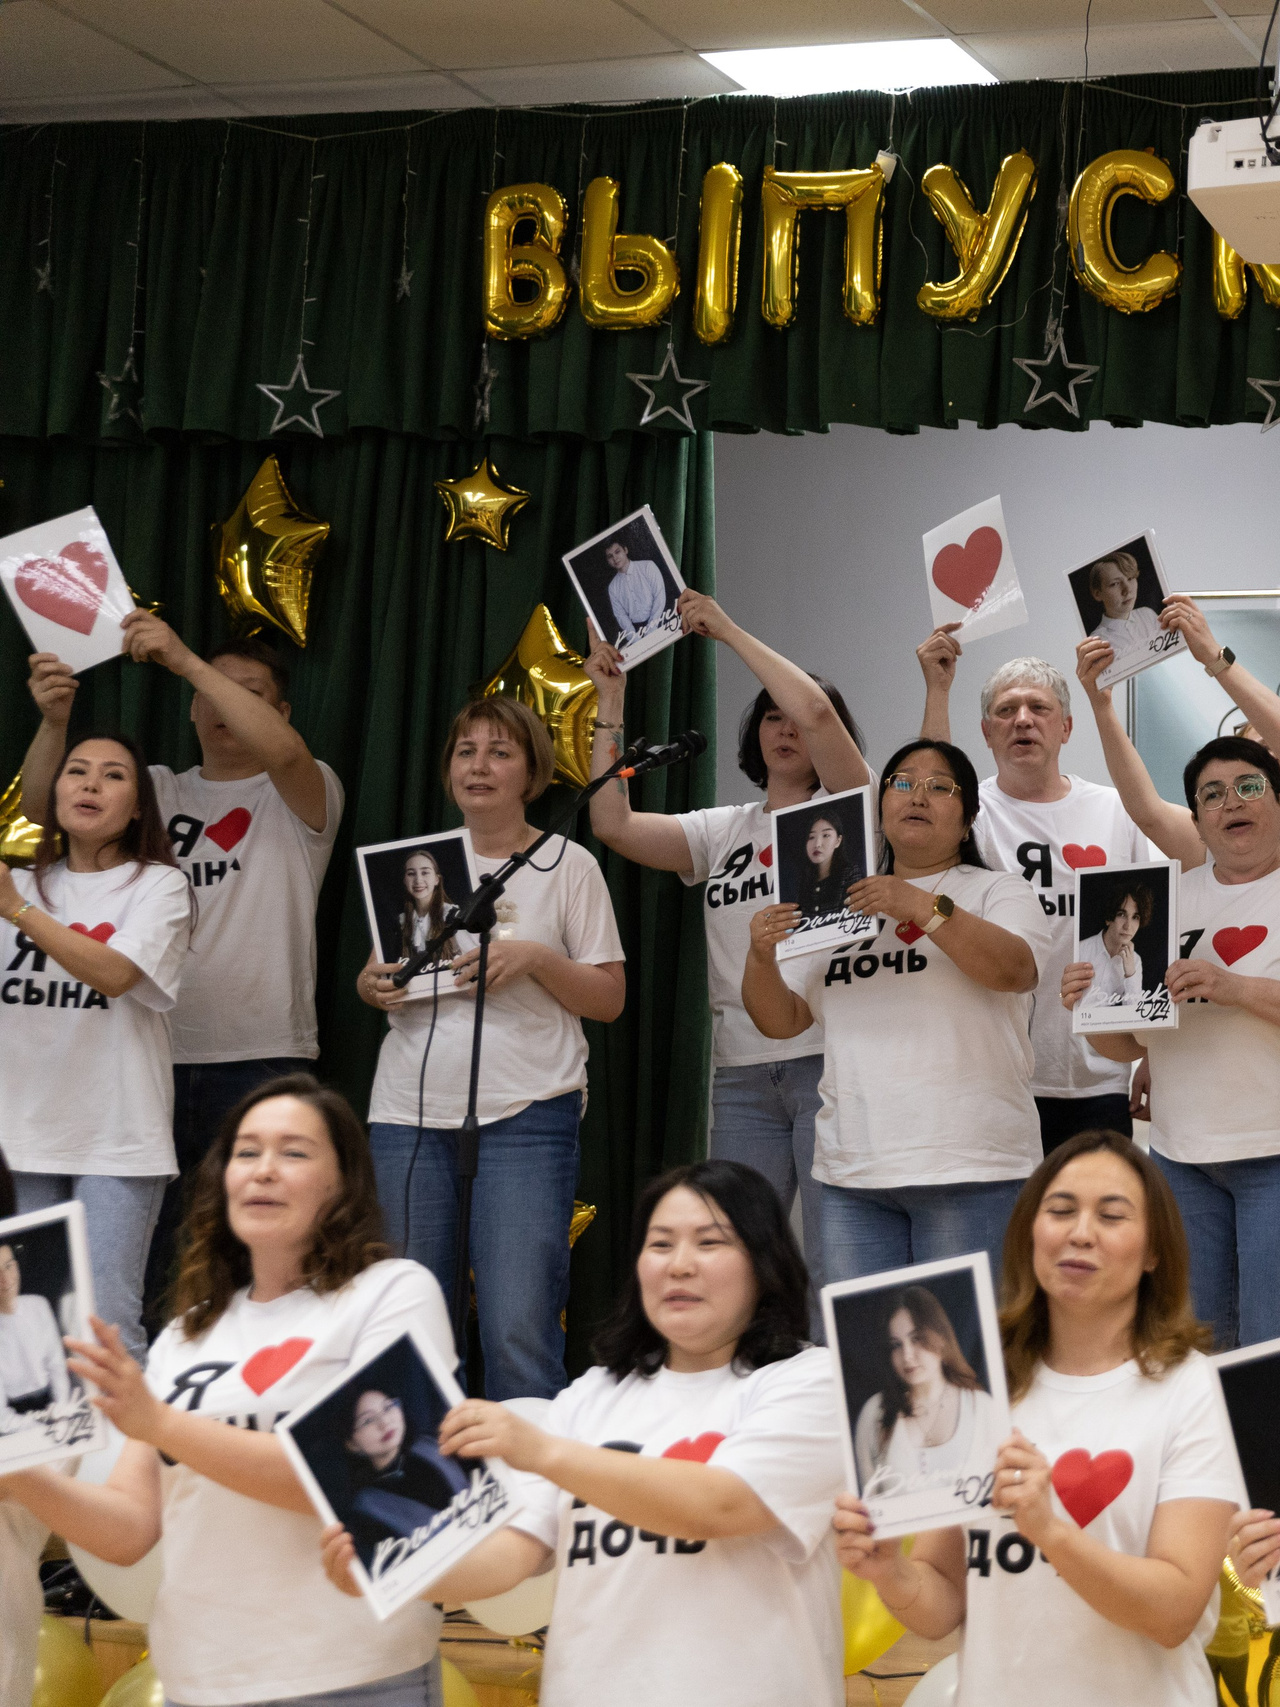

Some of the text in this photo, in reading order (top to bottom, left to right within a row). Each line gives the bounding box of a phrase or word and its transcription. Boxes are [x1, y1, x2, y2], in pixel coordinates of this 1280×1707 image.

[167, 813, 205, 857] Я
[709, 842, 754, 879] Я
[1017, 841, 1053, 888] Я
[707, 872, 774, 909] СЫН
[6, 930, 48, 972] Я
[825, 948, 928, 987] ДОЧЬ
[1, 977, 109, 1010] СЫНА
[1135, 1000, 1170, 1022] 2024
[164, 1361, 238, 1412] Я
[954, 1471, 995, 1507] 202
